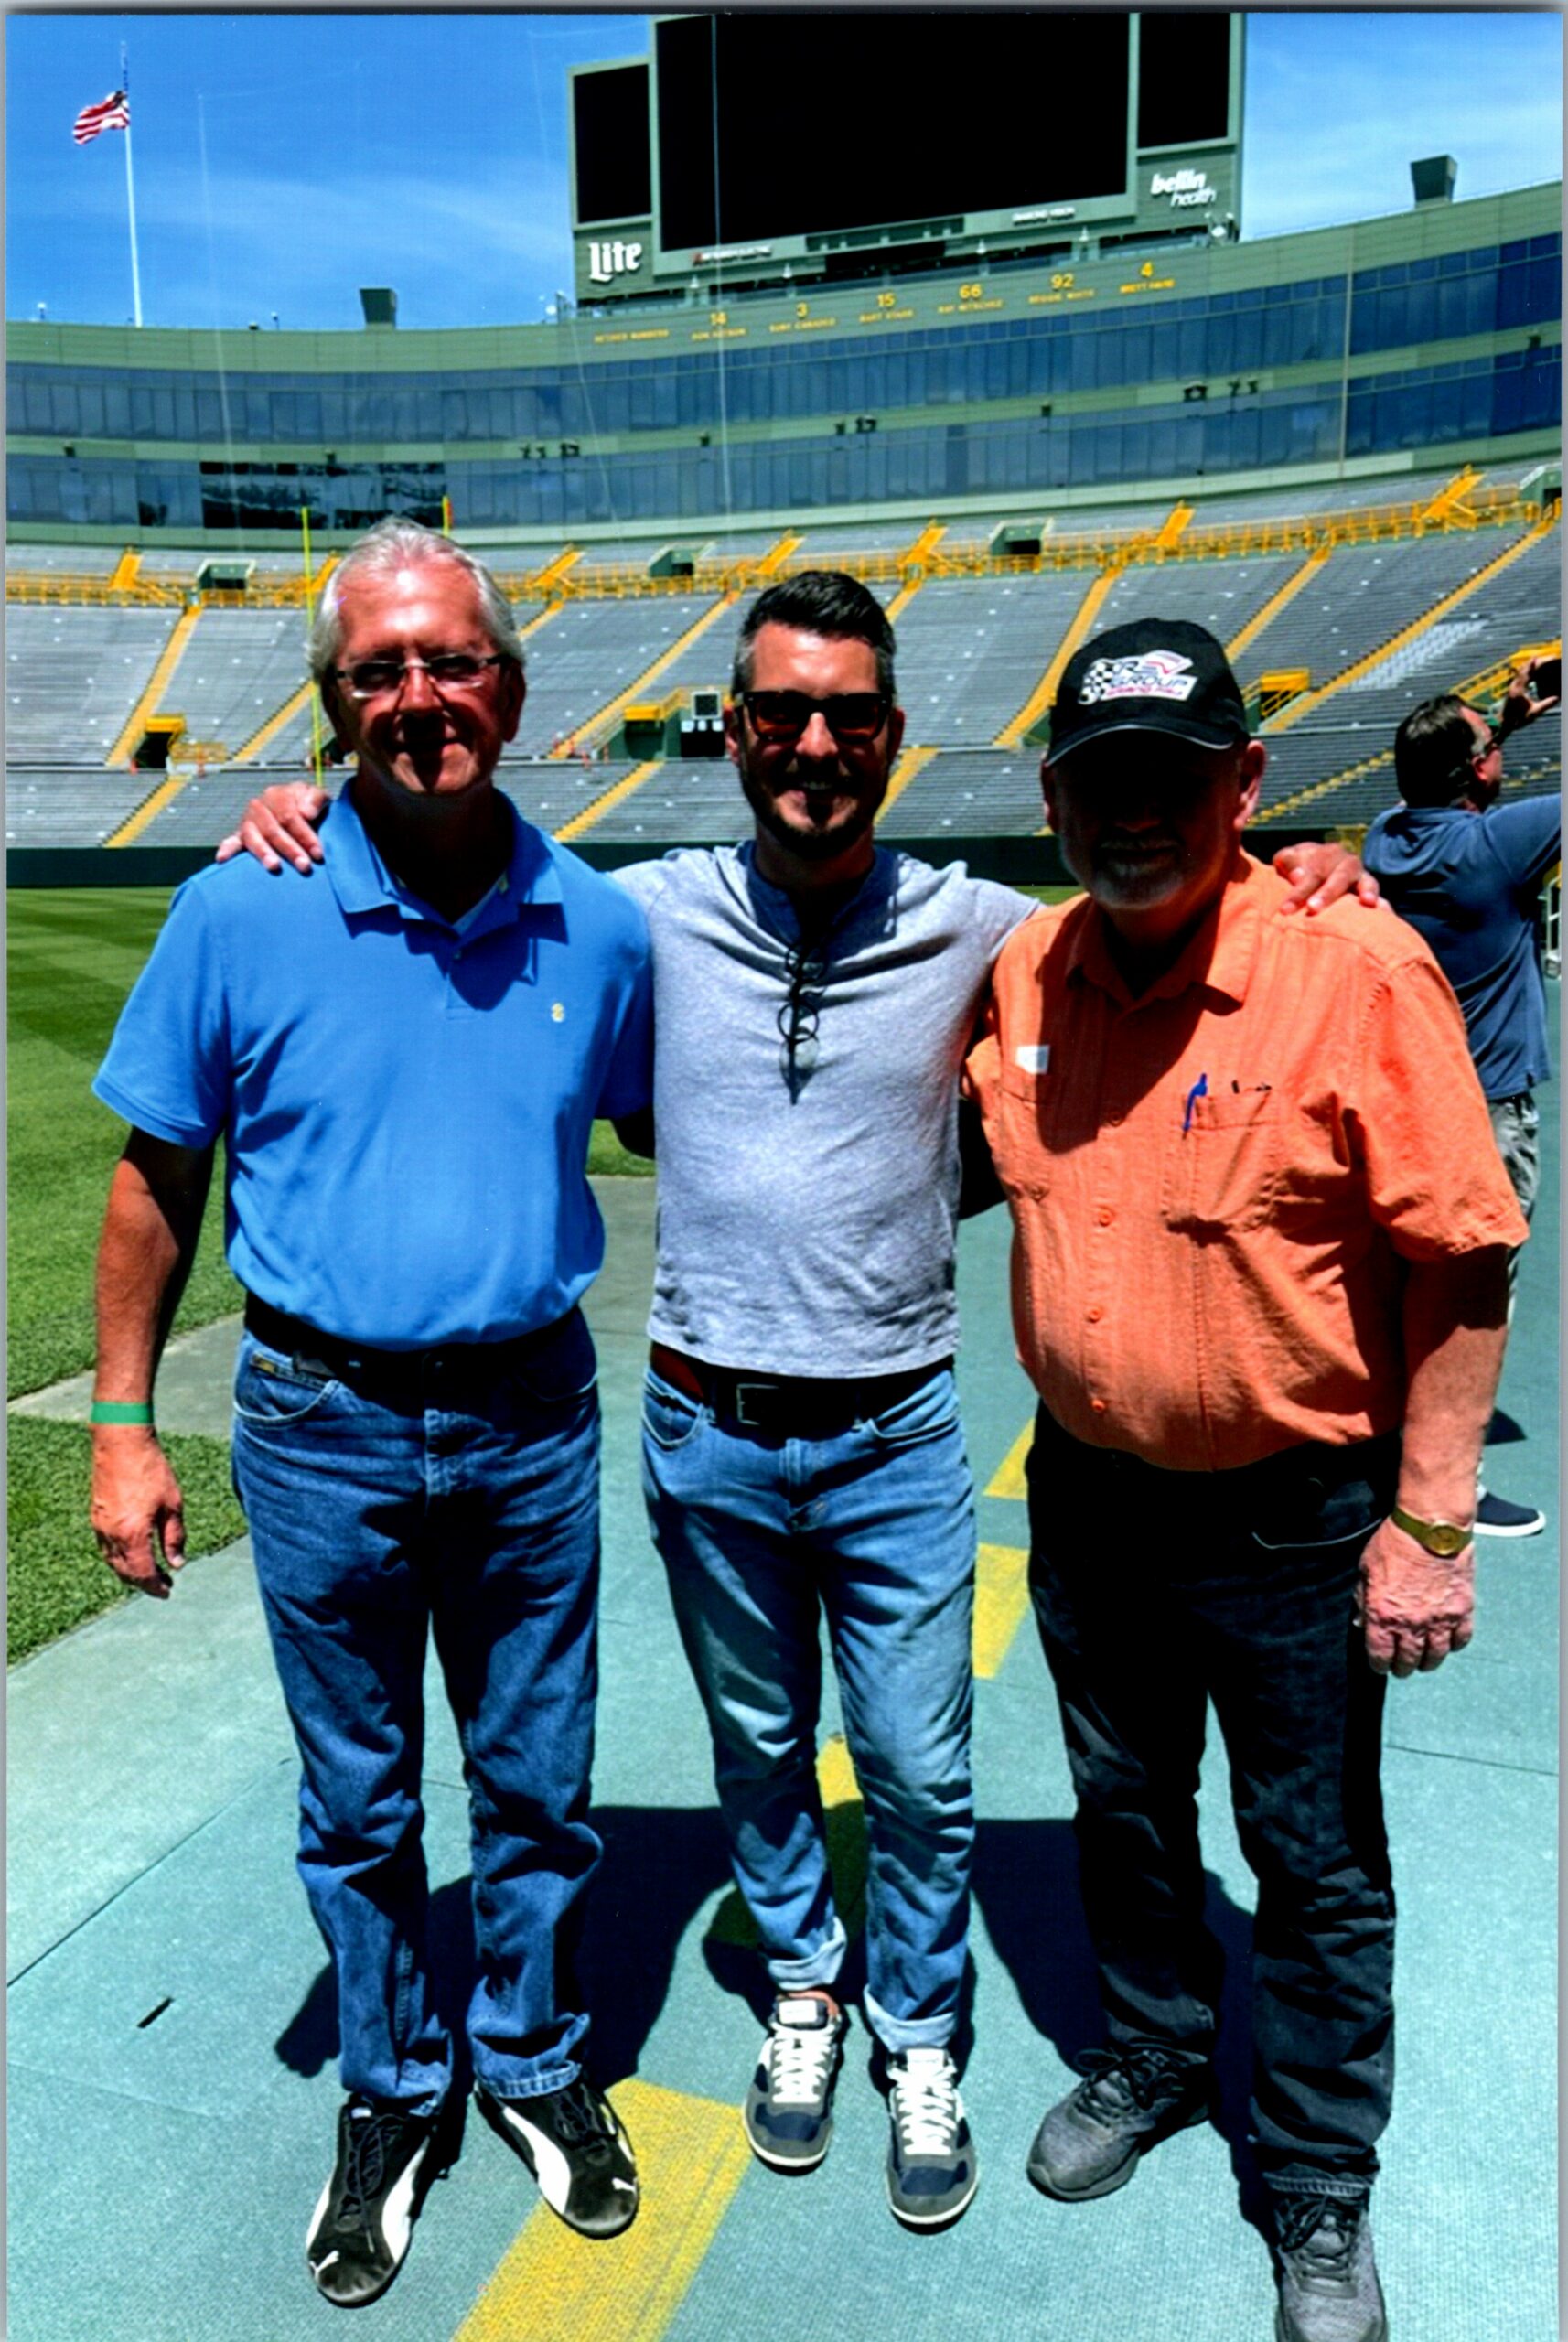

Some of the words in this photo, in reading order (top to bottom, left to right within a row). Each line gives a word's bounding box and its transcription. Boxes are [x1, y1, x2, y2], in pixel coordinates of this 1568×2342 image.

[1150, 169, 1207, 195] bellin
[1171, 187, 1217, 207] health
[588, 241, 642, 282] Lite
[1141, 261, 1154, 277] 4
[1050, 274, 1074, 289] 92
[959, 283, 983, 299] 66
[876, 293, 896, 308] 15
[796, 302, 809, 318] 3
